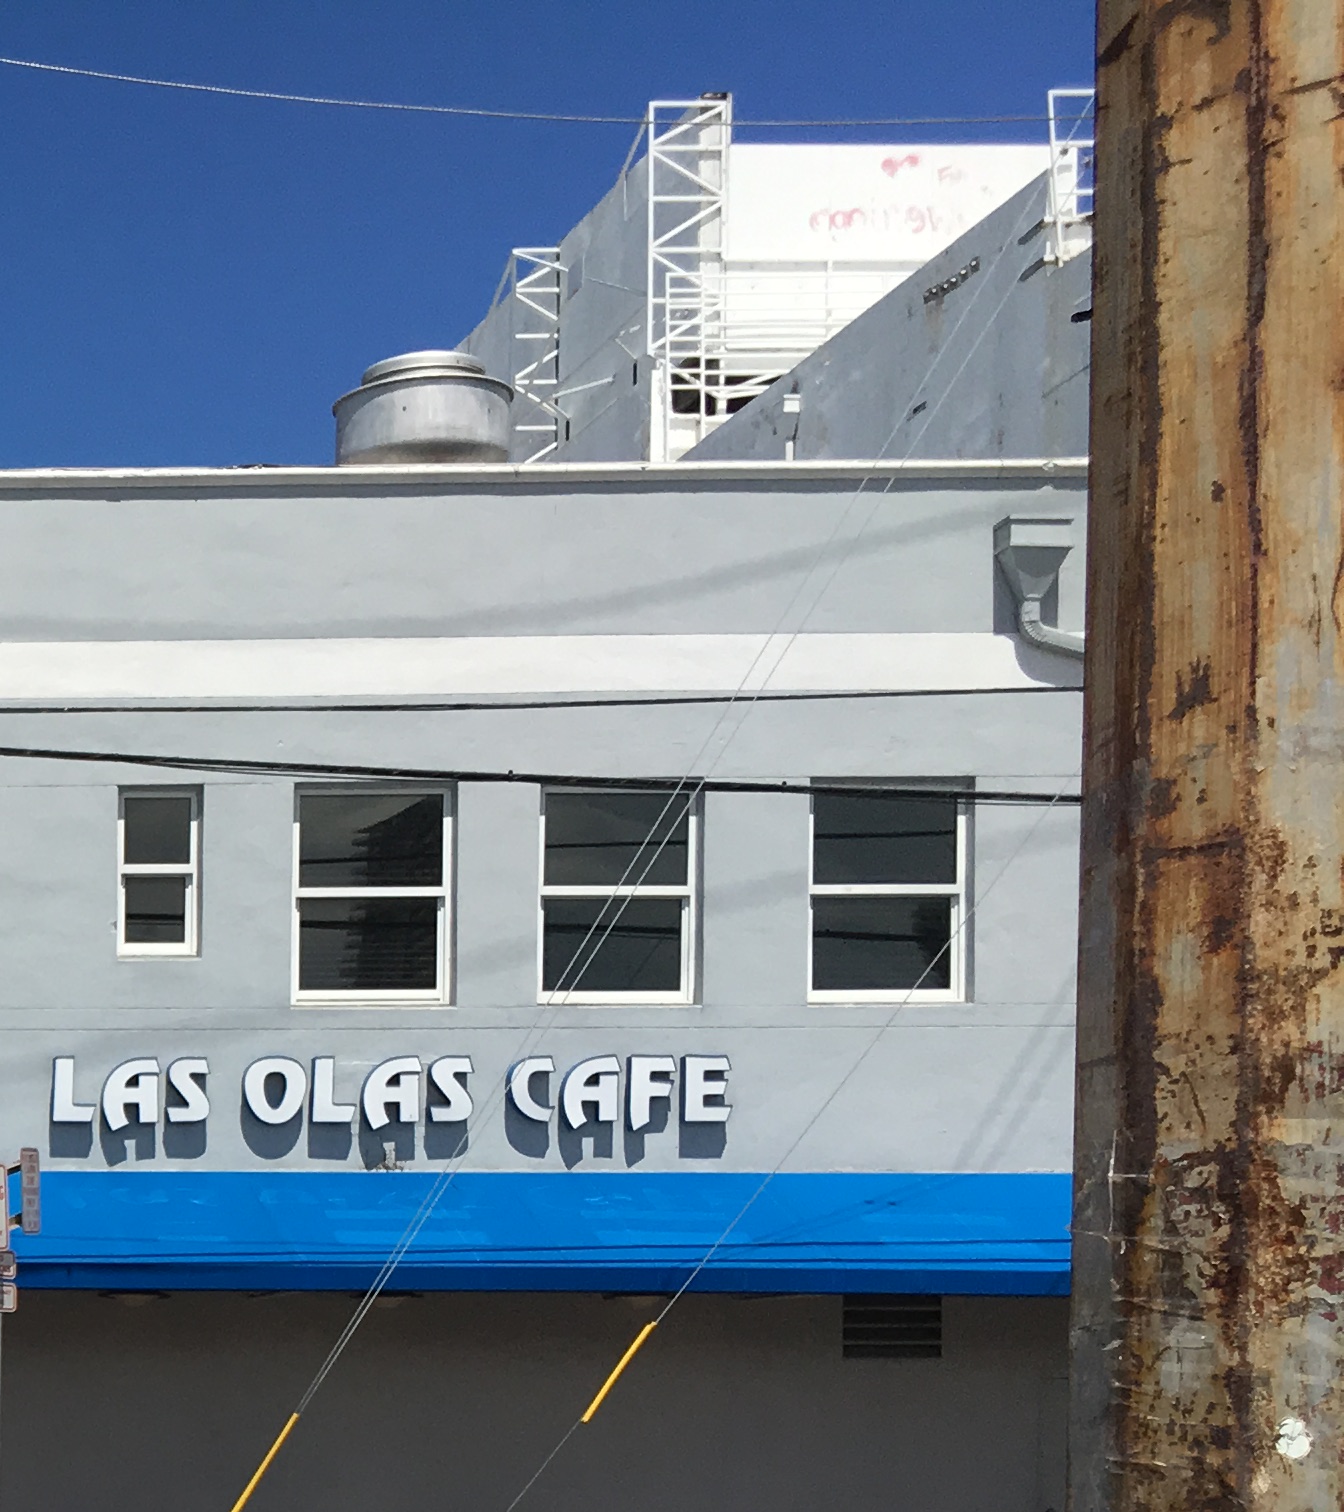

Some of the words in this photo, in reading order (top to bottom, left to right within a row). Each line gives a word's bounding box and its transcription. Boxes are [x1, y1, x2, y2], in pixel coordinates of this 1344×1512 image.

[51, 1055, 210, 1131] LAS
[241, 1055, 474, 1131] OLAS
[509, 1054, 733, 1131] CAFE
